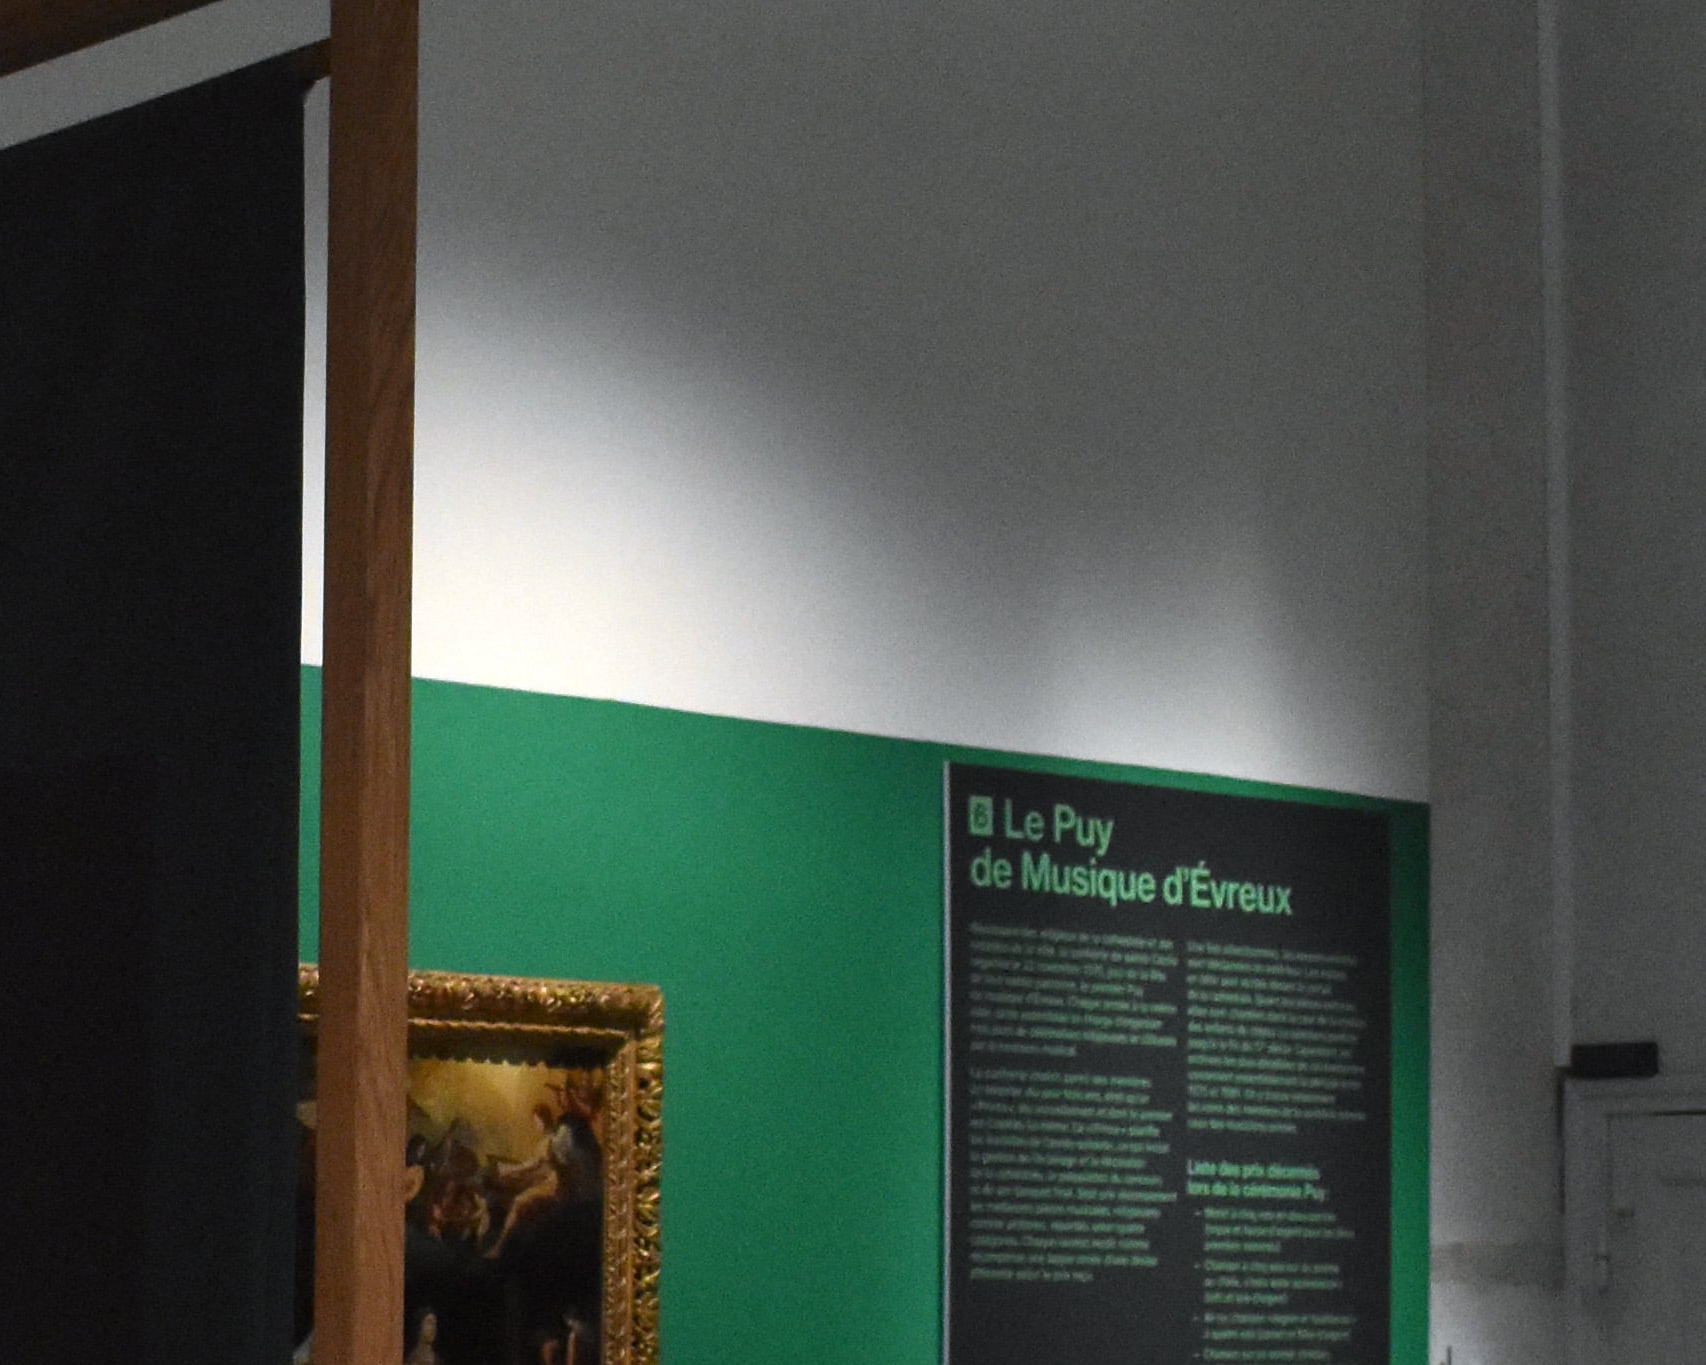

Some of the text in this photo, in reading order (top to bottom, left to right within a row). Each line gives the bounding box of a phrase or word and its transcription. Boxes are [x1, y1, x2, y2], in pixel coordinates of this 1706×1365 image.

[1004, 798, 1044, 841] Le
[1054, 804, 1114, 856] Puy
[970, 847, 1012, 888] de
[1021, 851, 1156, 908] Musique
